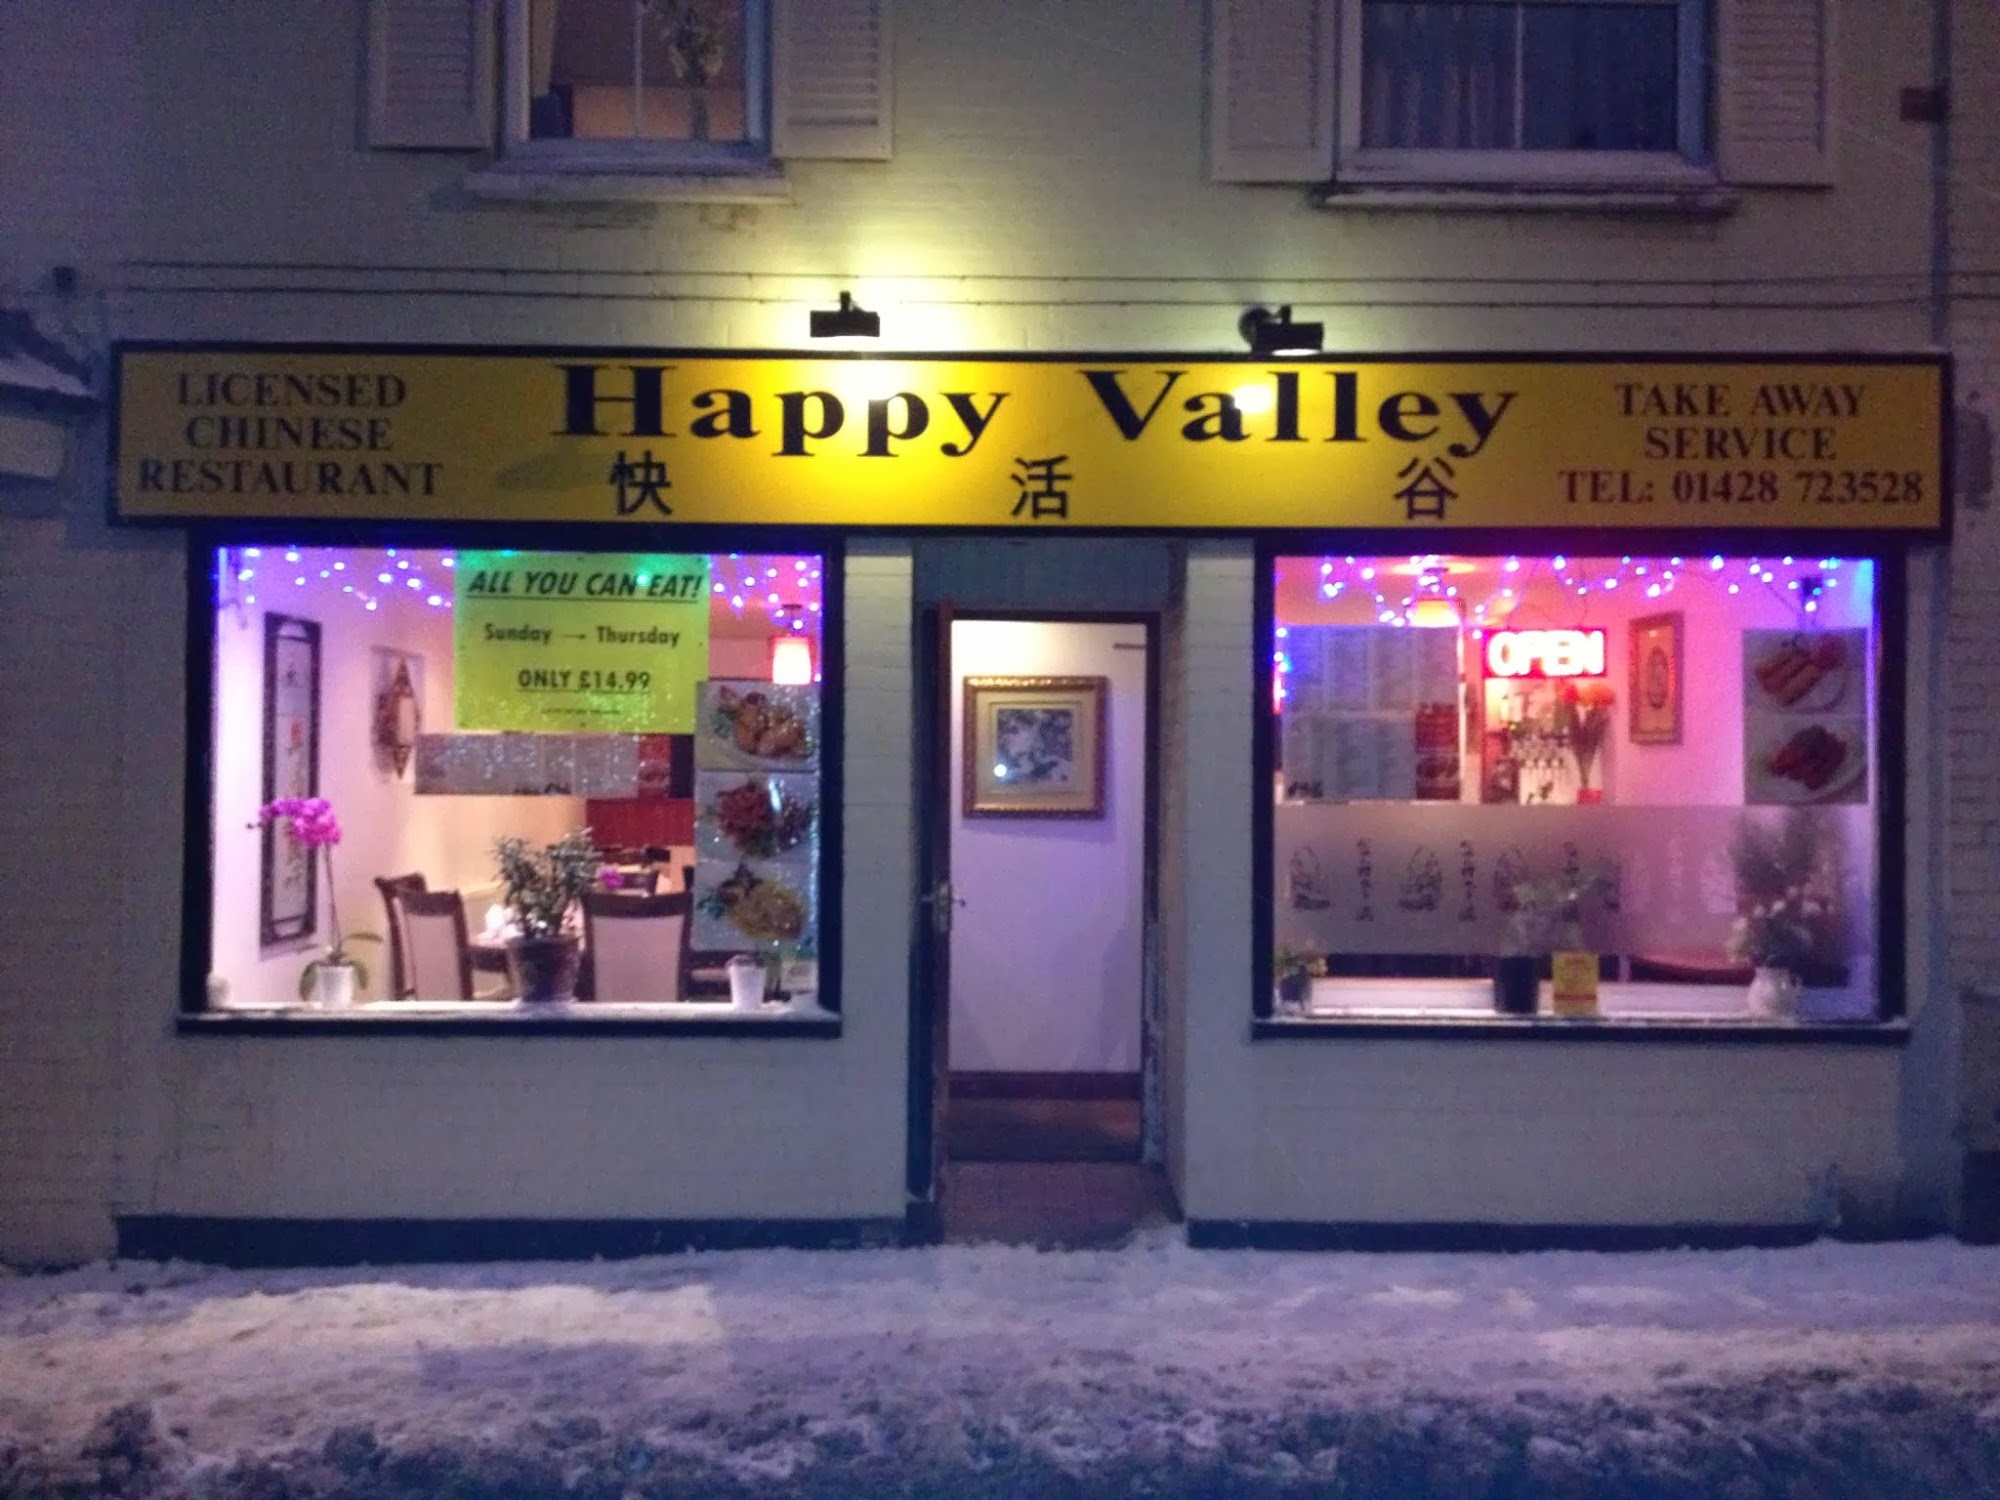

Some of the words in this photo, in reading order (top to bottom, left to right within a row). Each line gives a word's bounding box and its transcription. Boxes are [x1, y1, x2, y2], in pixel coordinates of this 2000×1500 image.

[178, 372, 407, 408] LICENSED
[1614, 383, 1731, 418] TAKE
[1750, 384, 1866, 418] AWAY
[549, 364, 1010, 457] Happy
[1078, 370, 1519, 458] Valley
[185, 416, 392, 452] CHINESE
[1643, 426, 1838, 461] SERVICE
[138, 460, 444, 497] RESTAURANT
[609, 450, 673, 516] 快
[1010, 454, 1073, 520] 活
[1394, 457, 1459, 520] 谷
[1558, 469, 1654, 503] TEL:
[1672, 470, 1780, 503] 01428
[1795, 471, 1924, 504] 723528
[467, 570, 512, 593] ALL
[525, 571, 578, 595] YOU
[586, 573, 639, 596] CAN
[645, 574, 703, 598] EAT!
[484, 623, 552, 645] Sunday
[596, 625, 681, 648] Thursday
[1488, 630, 1605, 676] OPEN
[518, 669, 572, 689] ONLY
[579, 671, 651, 690] £14.99
